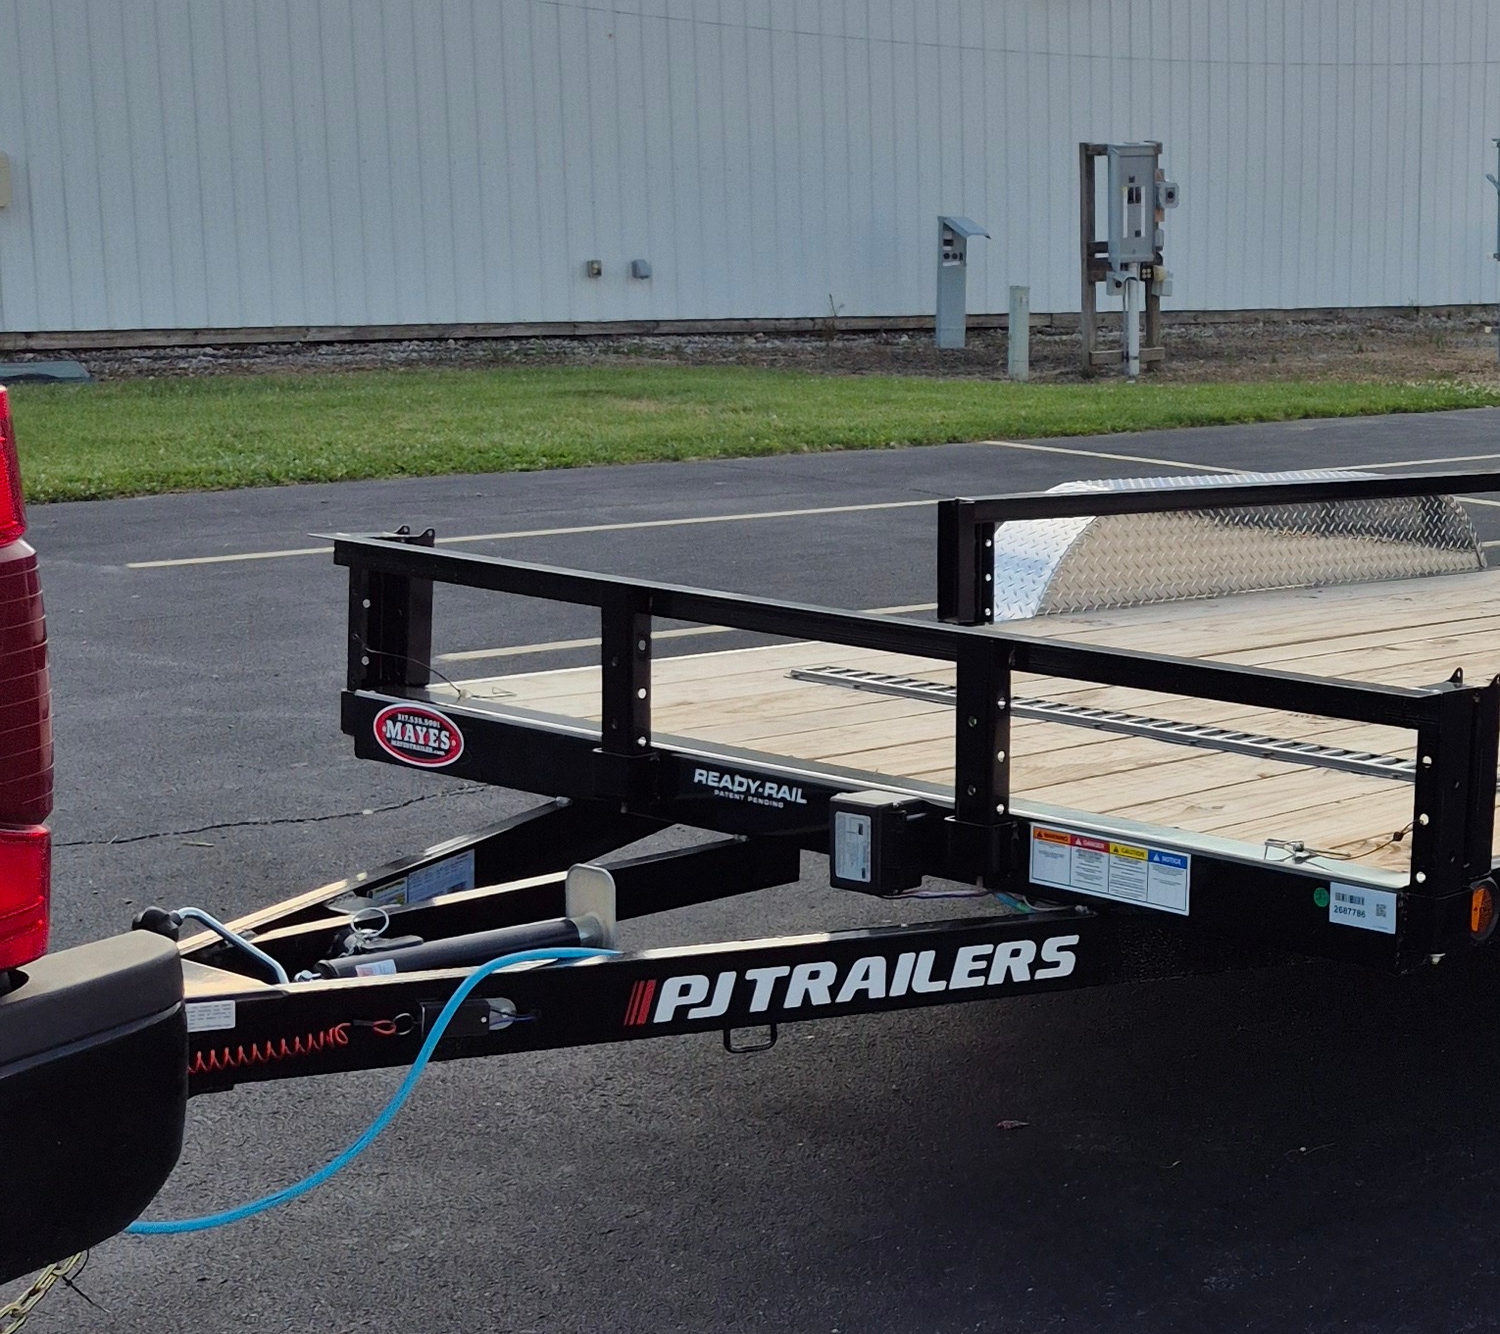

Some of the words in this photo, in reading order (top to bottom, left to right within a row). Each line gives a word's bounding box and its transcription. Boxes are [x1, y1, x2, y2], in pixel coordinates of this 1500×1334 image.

[385, 720, 450, 750] MAYES
[713, 789, 745, 801] PATENT
[747, 796, 784, 808] PENDING
[1120, 846, 1145, 858] CAUTION
[653, 971, 737, 1023] PJ
[745, 935, 1080, 1013] TRAILERS
